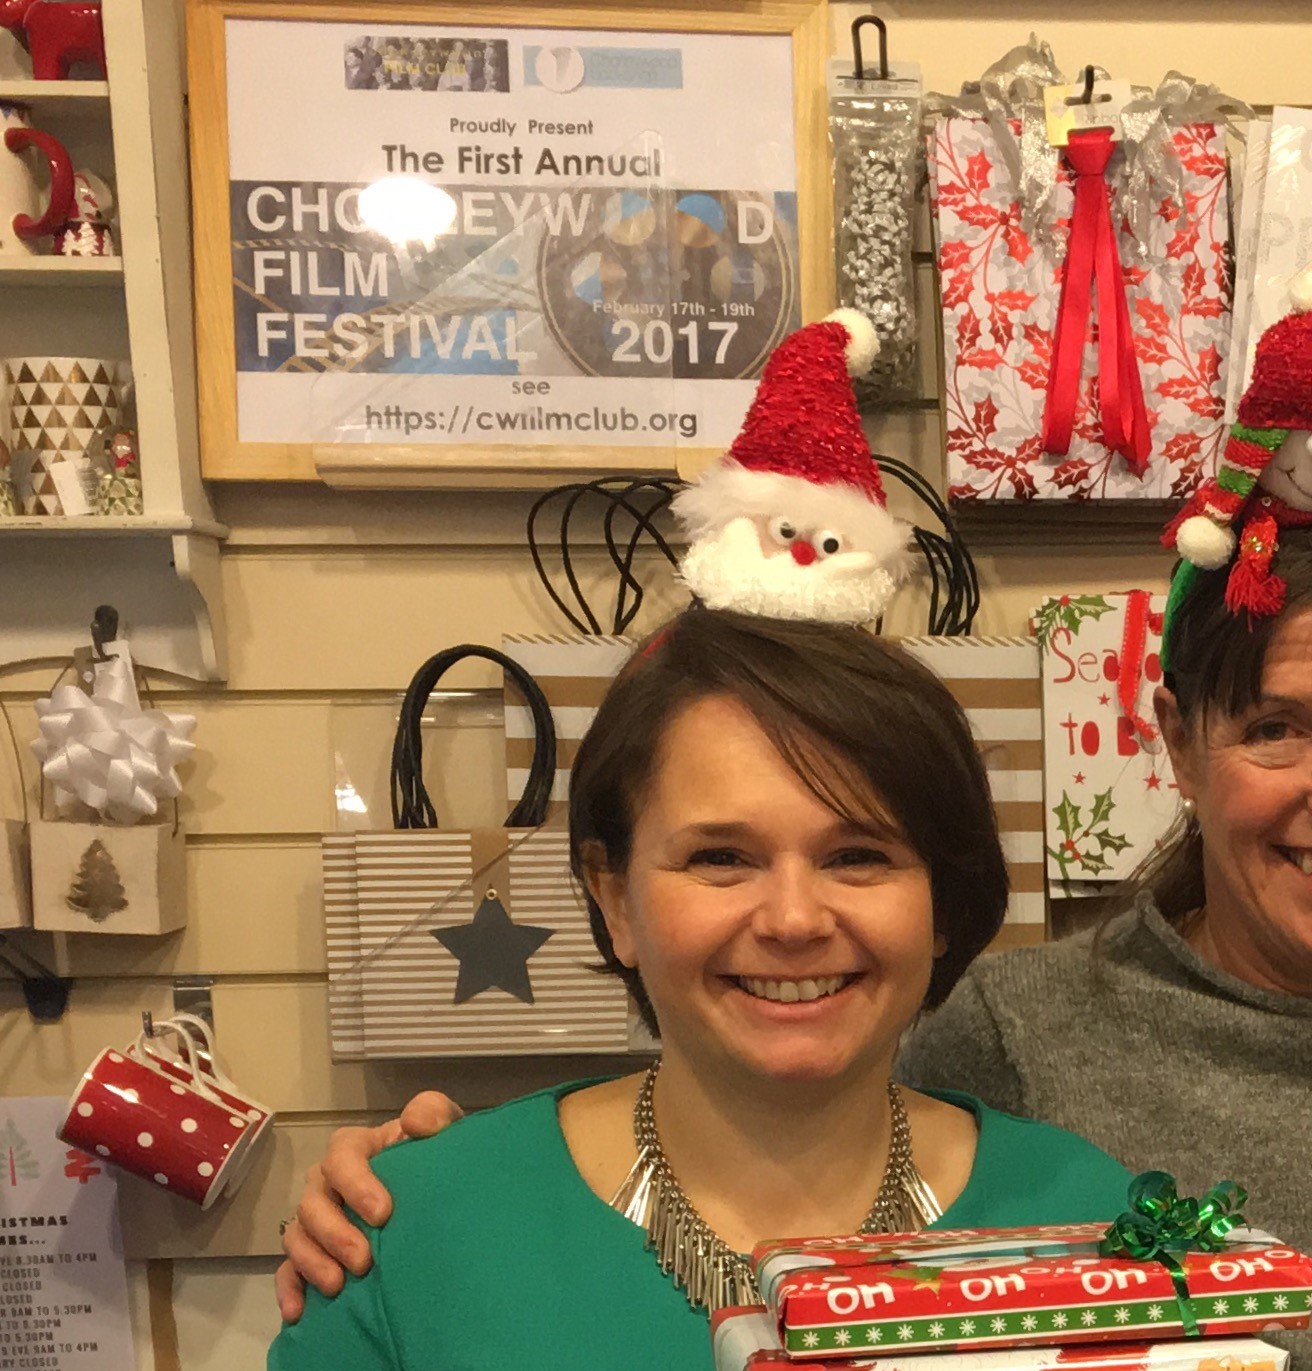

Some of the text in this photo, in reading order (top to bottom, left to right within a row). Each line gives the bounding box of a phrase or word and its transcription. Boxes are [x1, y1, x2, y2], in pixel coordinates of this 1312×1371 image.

[449, 117, 594, 137] Proudly Present
[381, 144, 661, 177] The First Annual
[253, 251, 389, 298] FILM
[669, 301, 711, 317] 17th
[724, 302, 756, 318] 19th
[256, 311, 539, 361] FESTIVAL
[611, 319, 740, 365] 2017
[511, 378, 551, 397] see
[1059, 712, 1101, 756] to
[2, 1281, 42, 1292] CLOSED
[76, 1341, 99, 1353] 4PM
